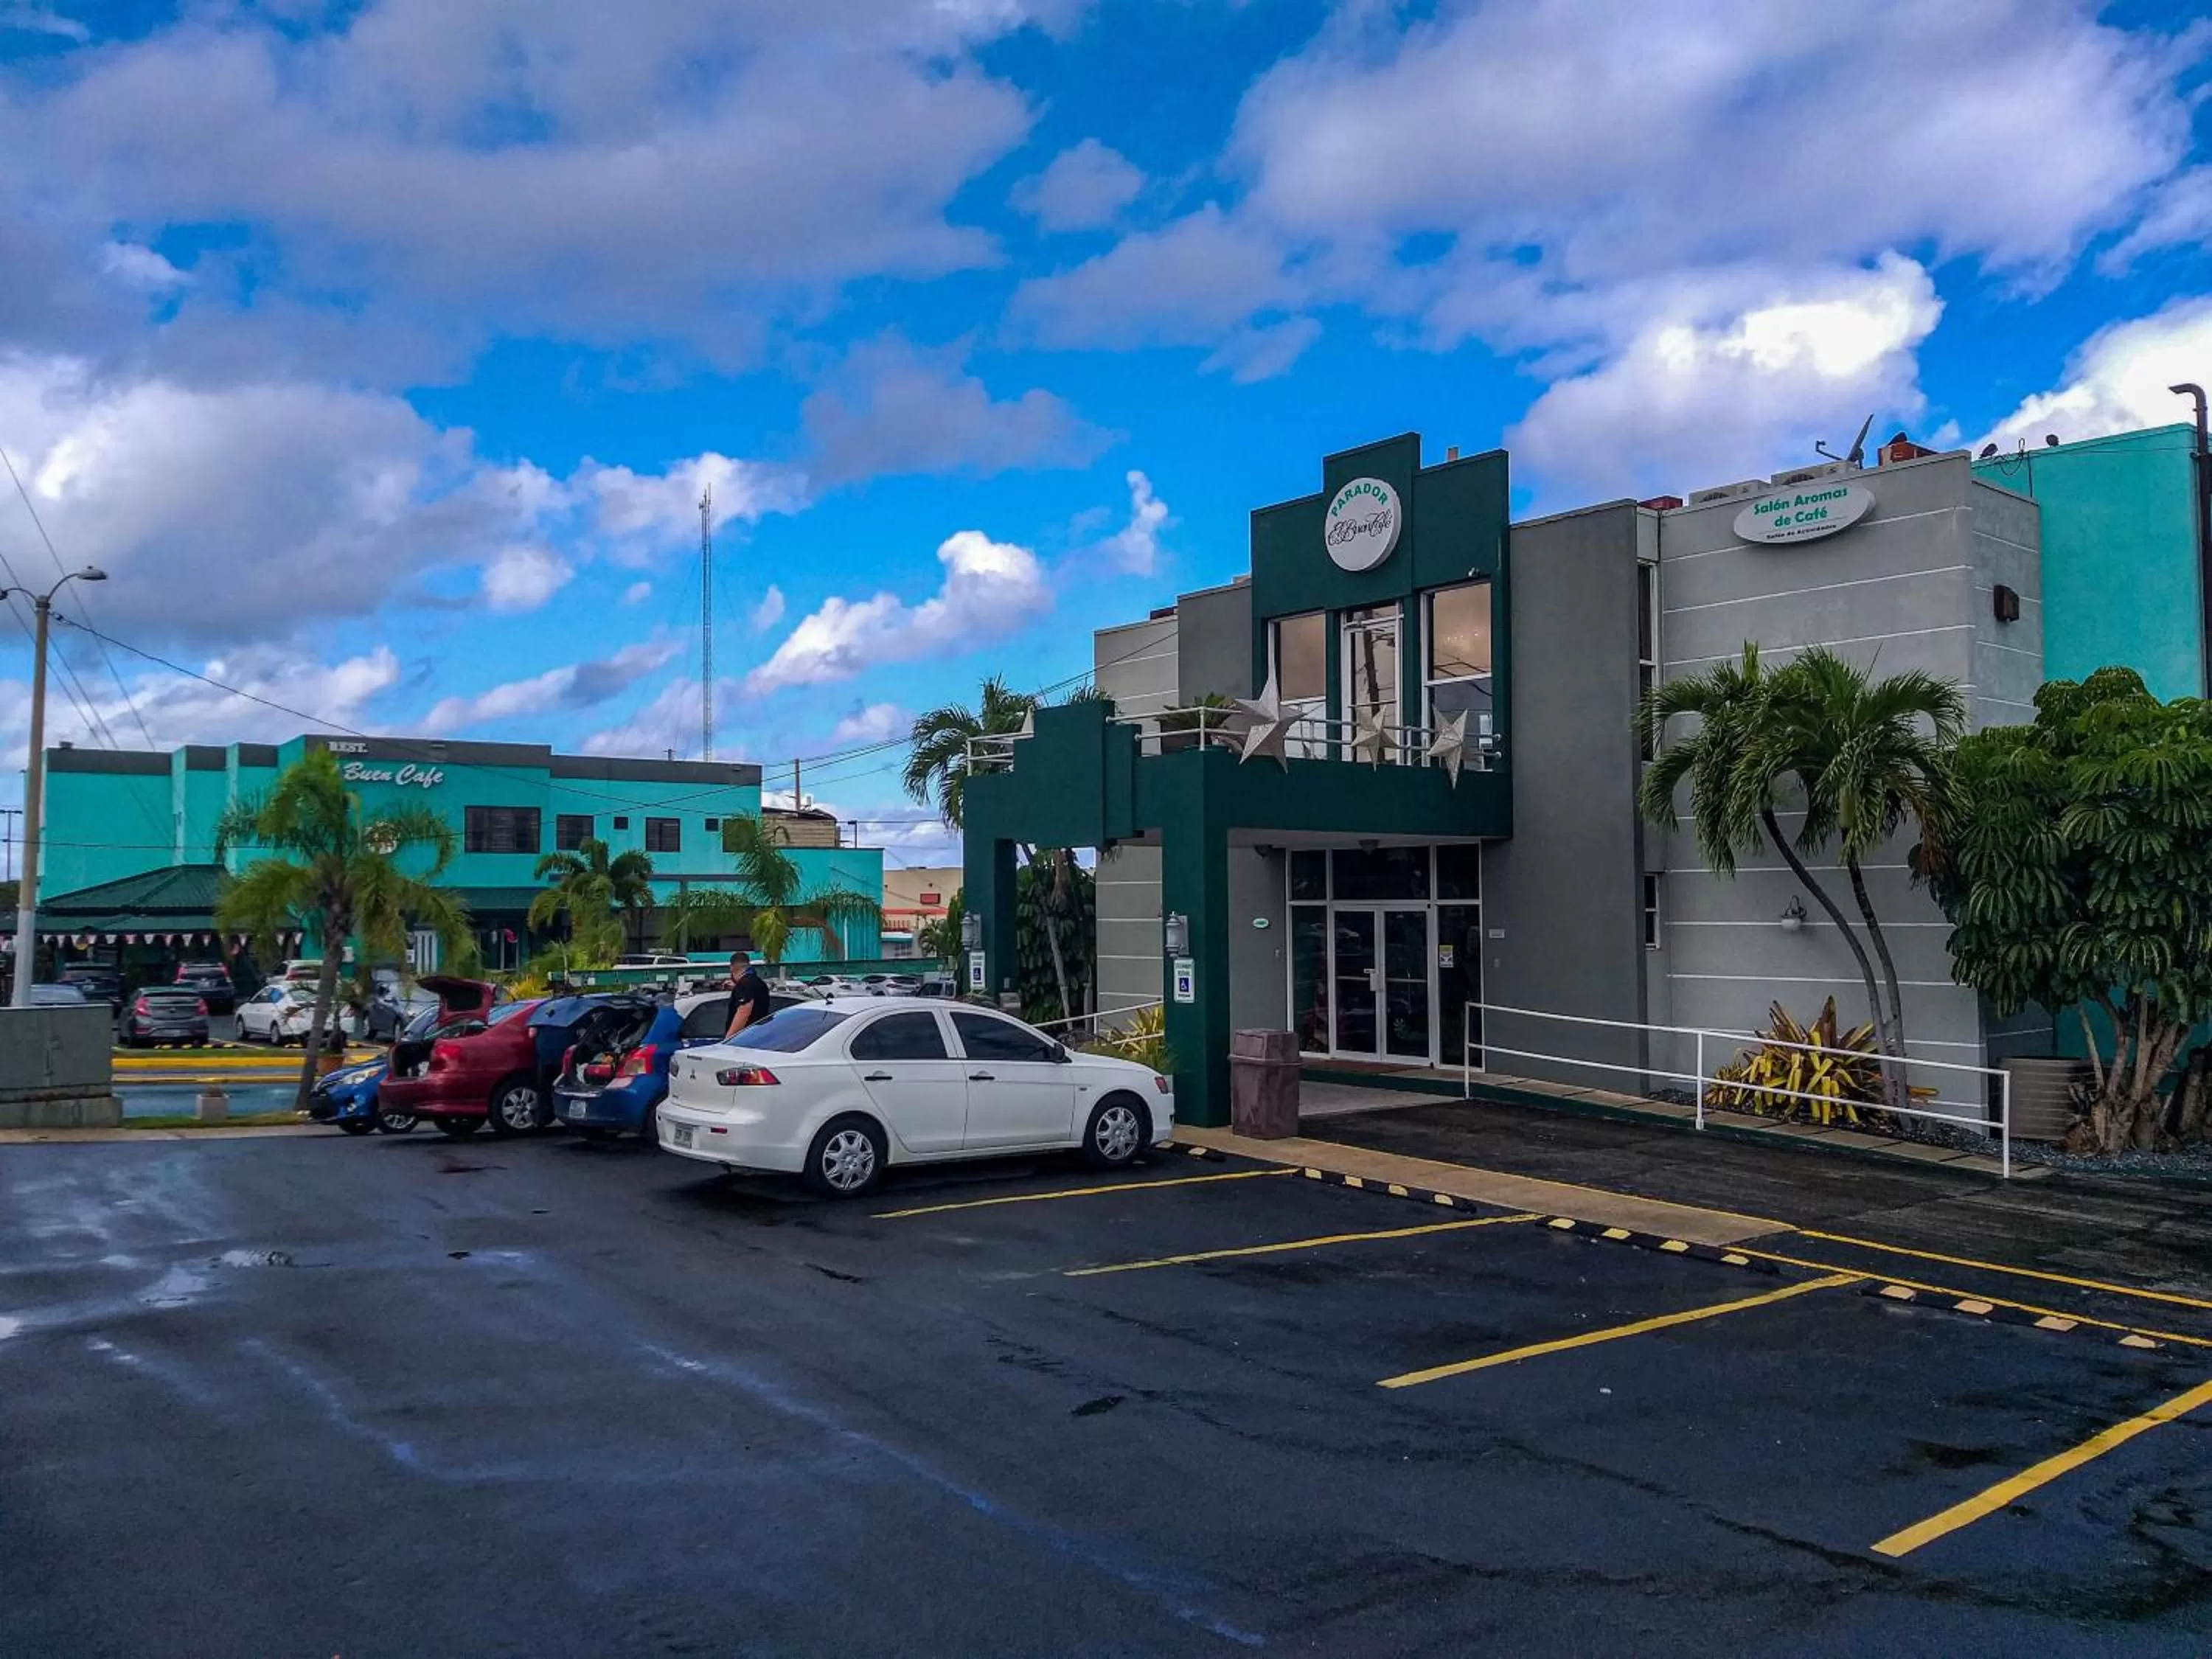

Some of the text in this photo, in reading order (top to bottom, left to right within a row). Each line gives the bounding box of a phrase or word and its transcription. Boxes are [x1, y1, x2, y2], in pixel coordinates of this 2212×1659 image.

[1331, 483, 1388, 517] PARADOR
[1753, 487, 1848, 515] Salón Aromas
[1774, 506, 1828, 527] de Café
[342, 762, 392, 781] Buen
